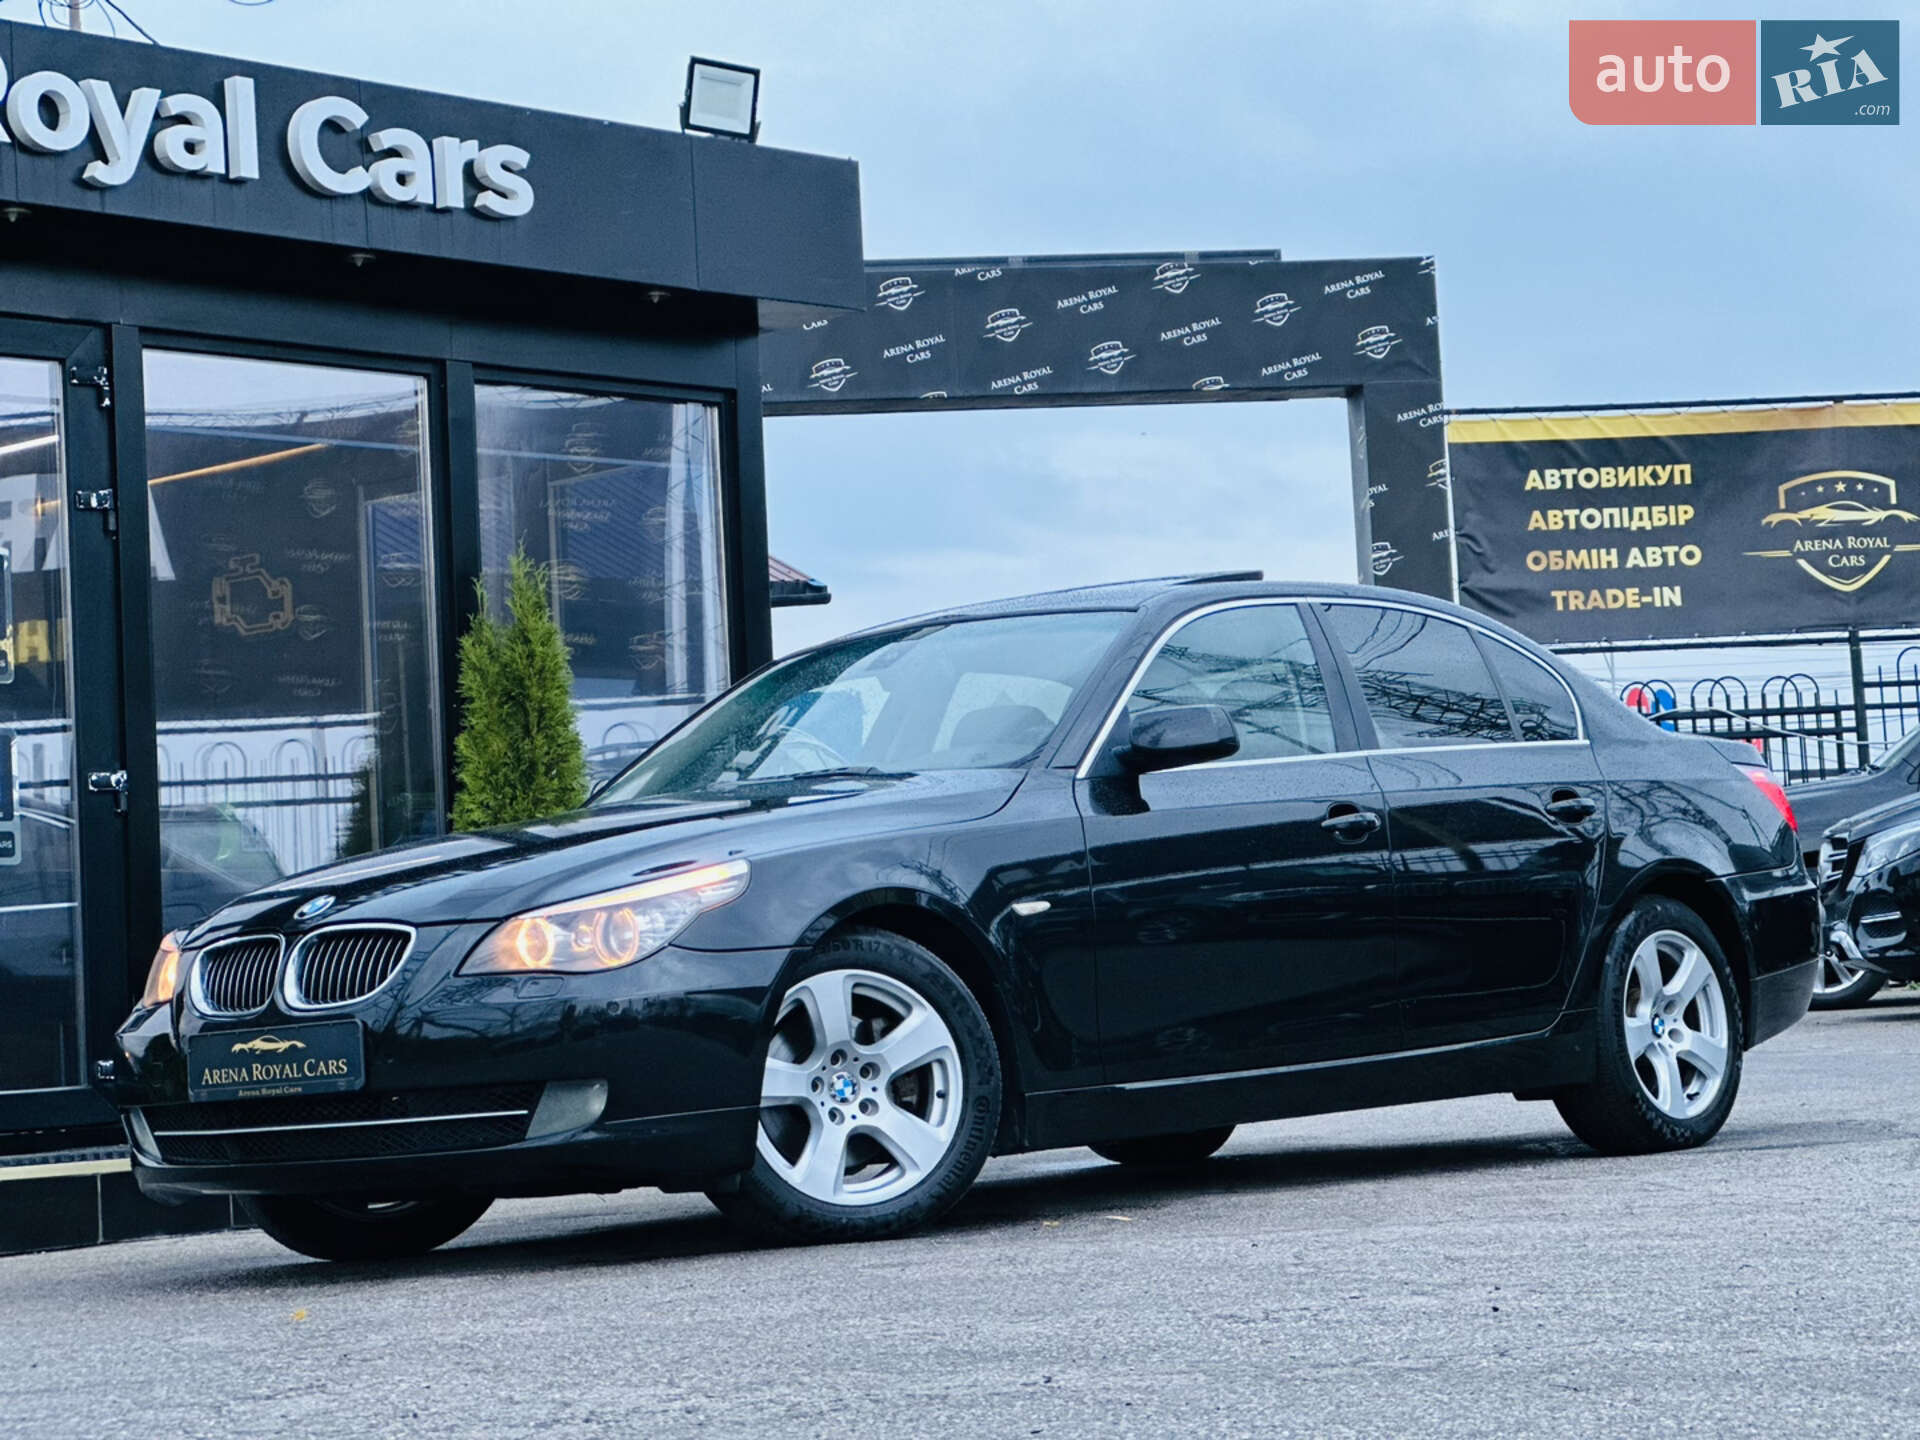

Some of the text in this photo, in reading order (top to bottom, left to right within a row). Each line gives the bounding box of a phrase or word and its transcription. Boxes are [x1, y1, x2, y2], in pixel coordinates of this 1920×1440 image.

[0, 53, 534, 218] oyal Cars
[1324, 270, 1385, 295] ARENA ROYAL
[1347, 286, 1370, 298] CARS
[1057, 285, 1118, 309] ARENA ROYAL
[1080, 301, 1104, 314] CARS
[1160, 317, 1222, 341] ARENA ROYAL
[1183, 333, 1207, 345] CARS
[883, 334, 946, 358] ARENA ROYAL
[906, 350, 931, 363] CARS
[1261, 352, 1322, 376] ARENA ROYAL
[1284, 368, 1308, 381] CARS
[991, 366, 1053, 390] ARENA ROYAL
[1013, 382, 1038, 394] CARS
[1397, 408, 1427, 422] ARENA
[1524, 463, 1692, 491] АВТОВИКУП
[1527, 504, 1695, 531] АВТОПІДБІР
[1794, 536, 1890, 553] ARENA ROYAL
[1526, 545, 1702, 571] ОБМІН АВТО
[1828, 553, 1865, 567] CARS
[1551, 586, 1682, 611] TRADE-IN
[201, 1058, 348, 1086] ARENA ROYAL CARS
